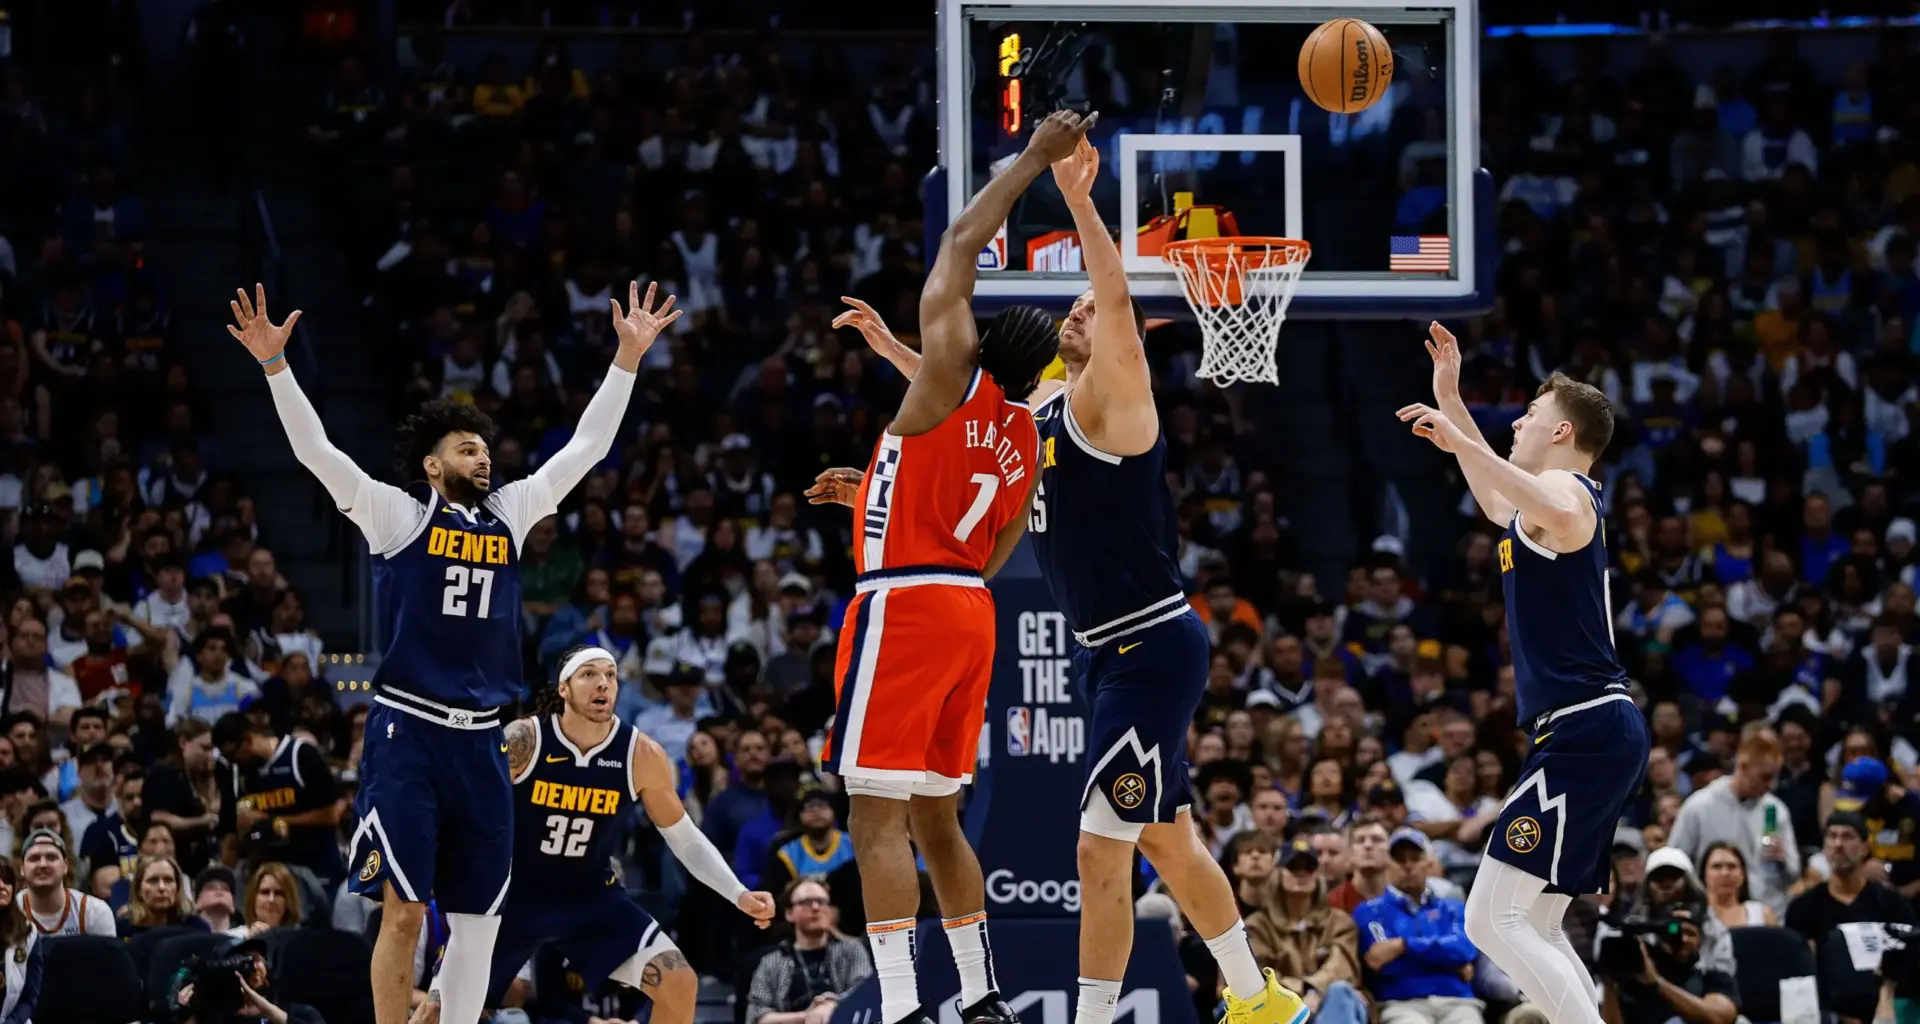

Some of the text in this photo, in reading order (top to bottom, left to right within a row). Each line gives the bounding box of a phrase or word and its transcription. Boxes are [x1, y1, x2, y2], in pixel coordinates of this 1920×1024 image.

[1350, 40, 1369, 102] Wilson
[965, 420, 1025, 487] HADEN
[953, 473, 1000, 543] 7
[1028, 480, 1047, 533] 5
[427, 526, 508, 565] DENVER
[442, 565, 494, 619] 27
[1018, 611, 1067, 656] GET
[1018, 659, 1072, 704] THE
[1032, 707, 1085, 764] App
[597, 758, 622, 769] ibotta
[531, 779, 620, 815] DENVER
[540, 814, 594, 857] 32
